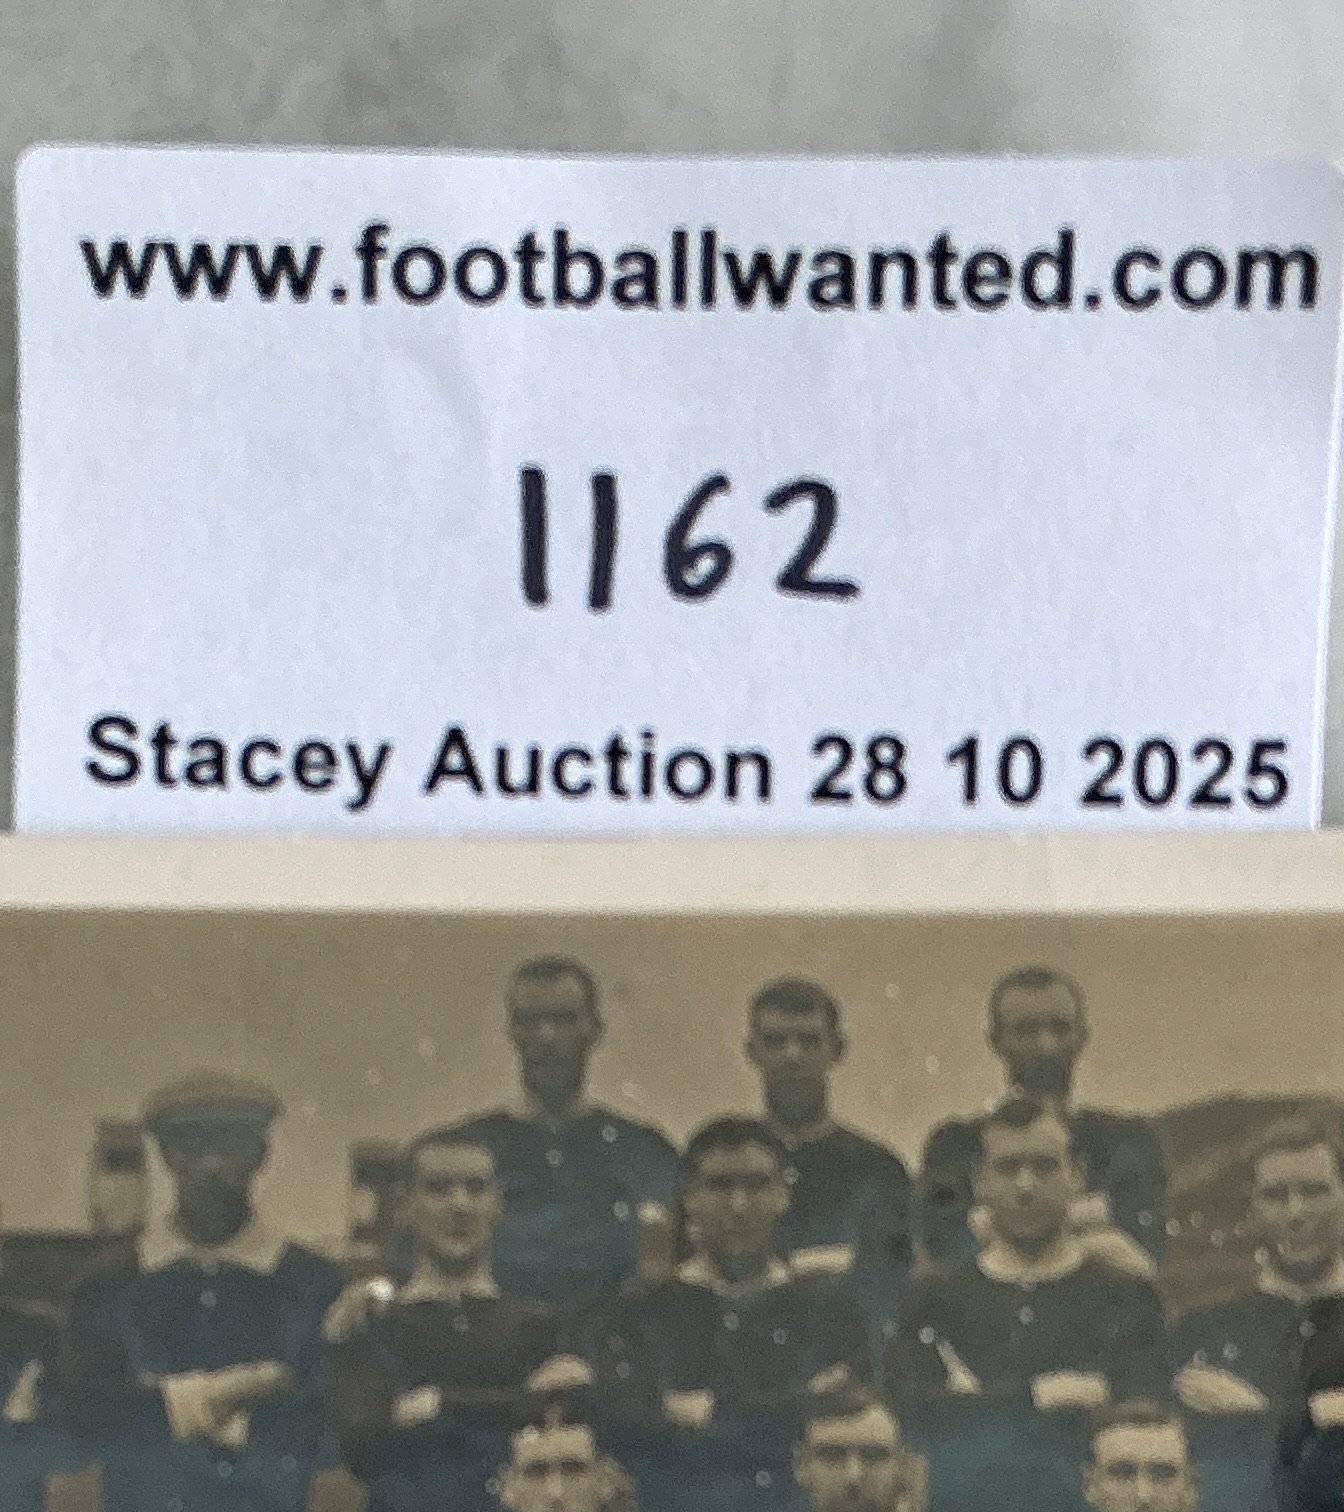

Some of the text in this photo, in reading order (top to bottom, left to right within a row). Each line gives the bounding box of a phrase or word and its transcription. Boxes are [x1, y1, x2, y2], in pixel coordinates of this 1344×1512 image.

[79, 220, 1321, 314] www.footballwanted.com
[519, 463, 862, 614] 1162
[84, 713, 1290, 814] Stacey Auction 28 10 2025
